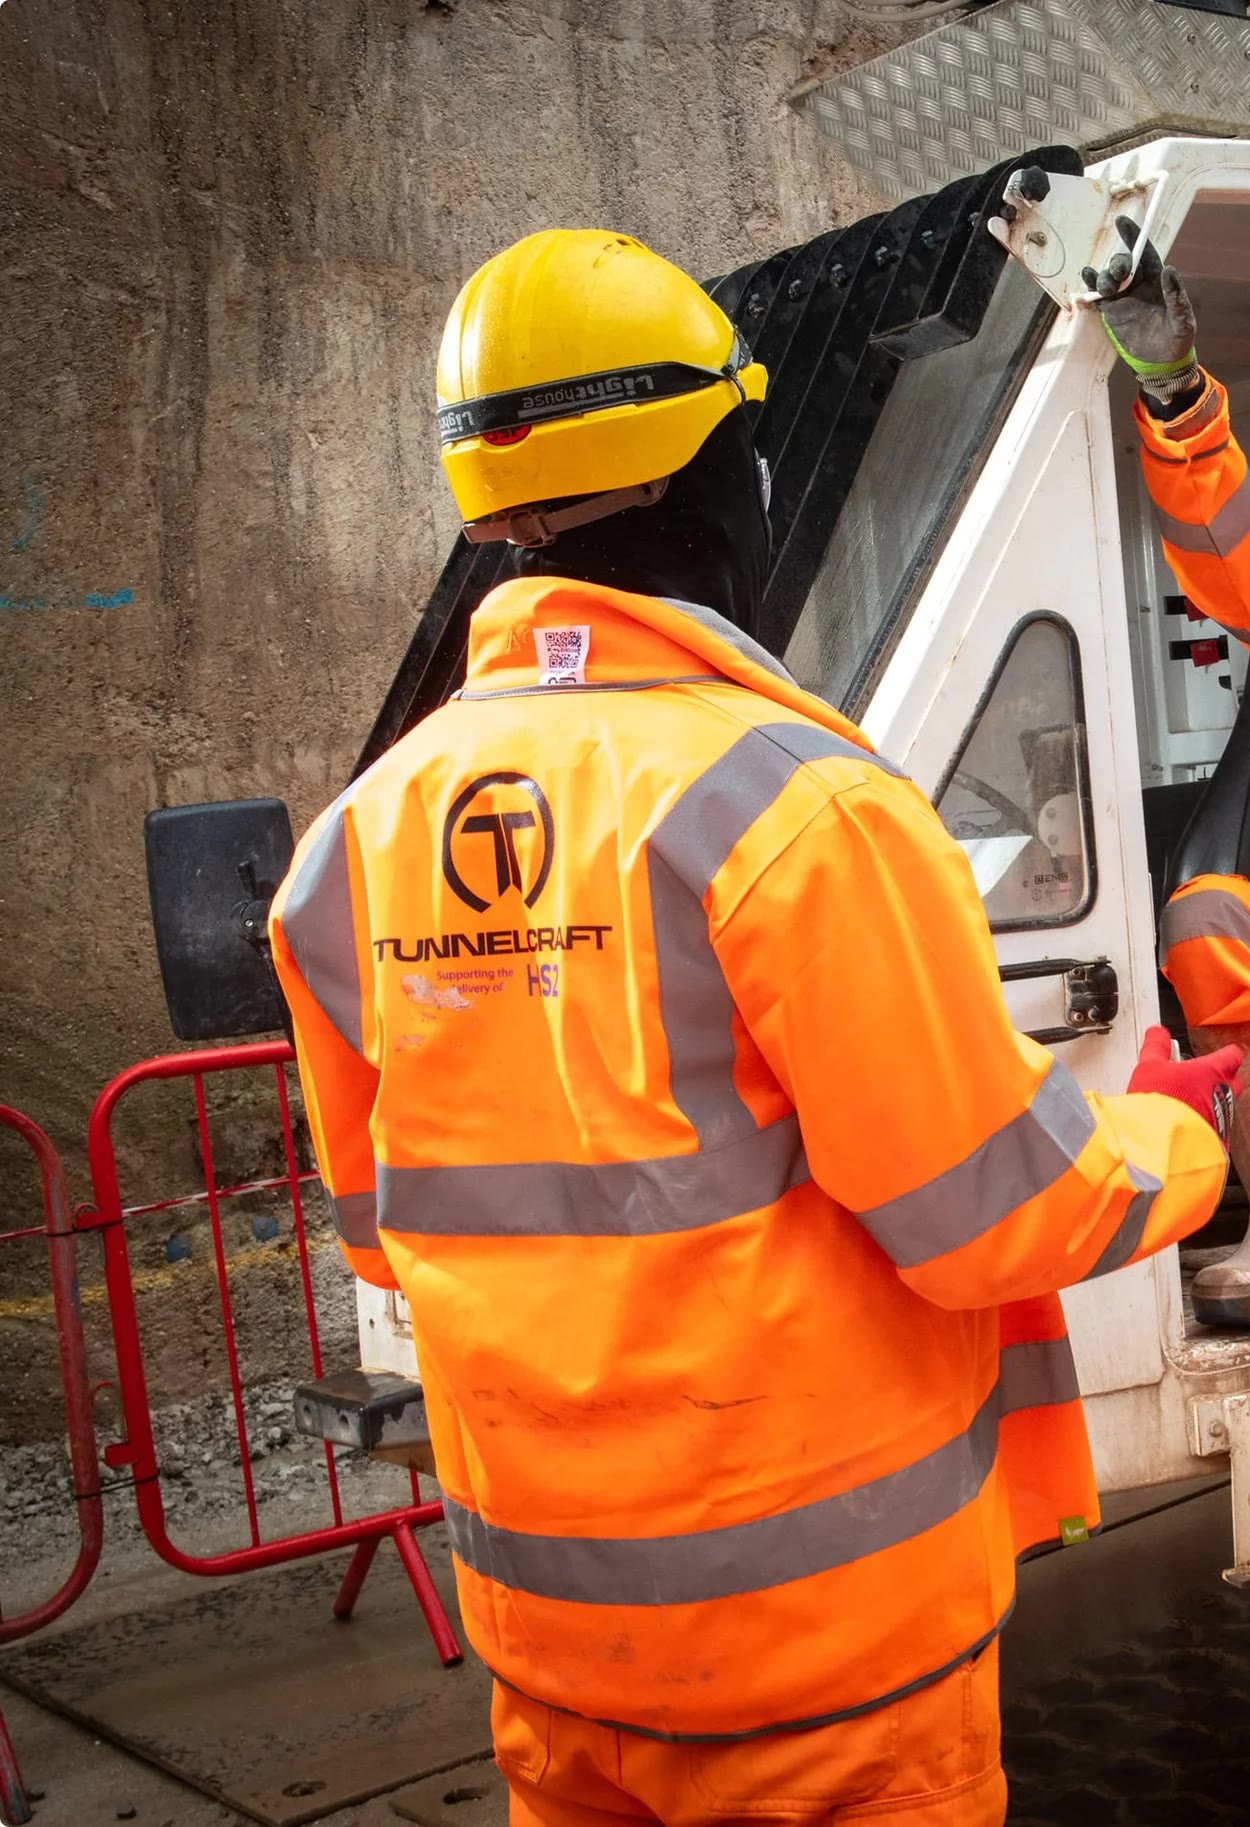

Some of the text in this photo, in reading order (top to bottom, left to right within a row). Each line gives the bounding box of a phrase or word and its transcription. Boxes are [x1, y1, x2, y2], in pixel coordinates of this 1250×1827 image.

[522, 374, 655, 409] Lighthouse
[373, 925, 613, 962] TUNNELCRAFT
[436, 967, 514, 981] Supporting the
[492, 982, 504, 992] of
[527, 963, 560, 998] HS2
